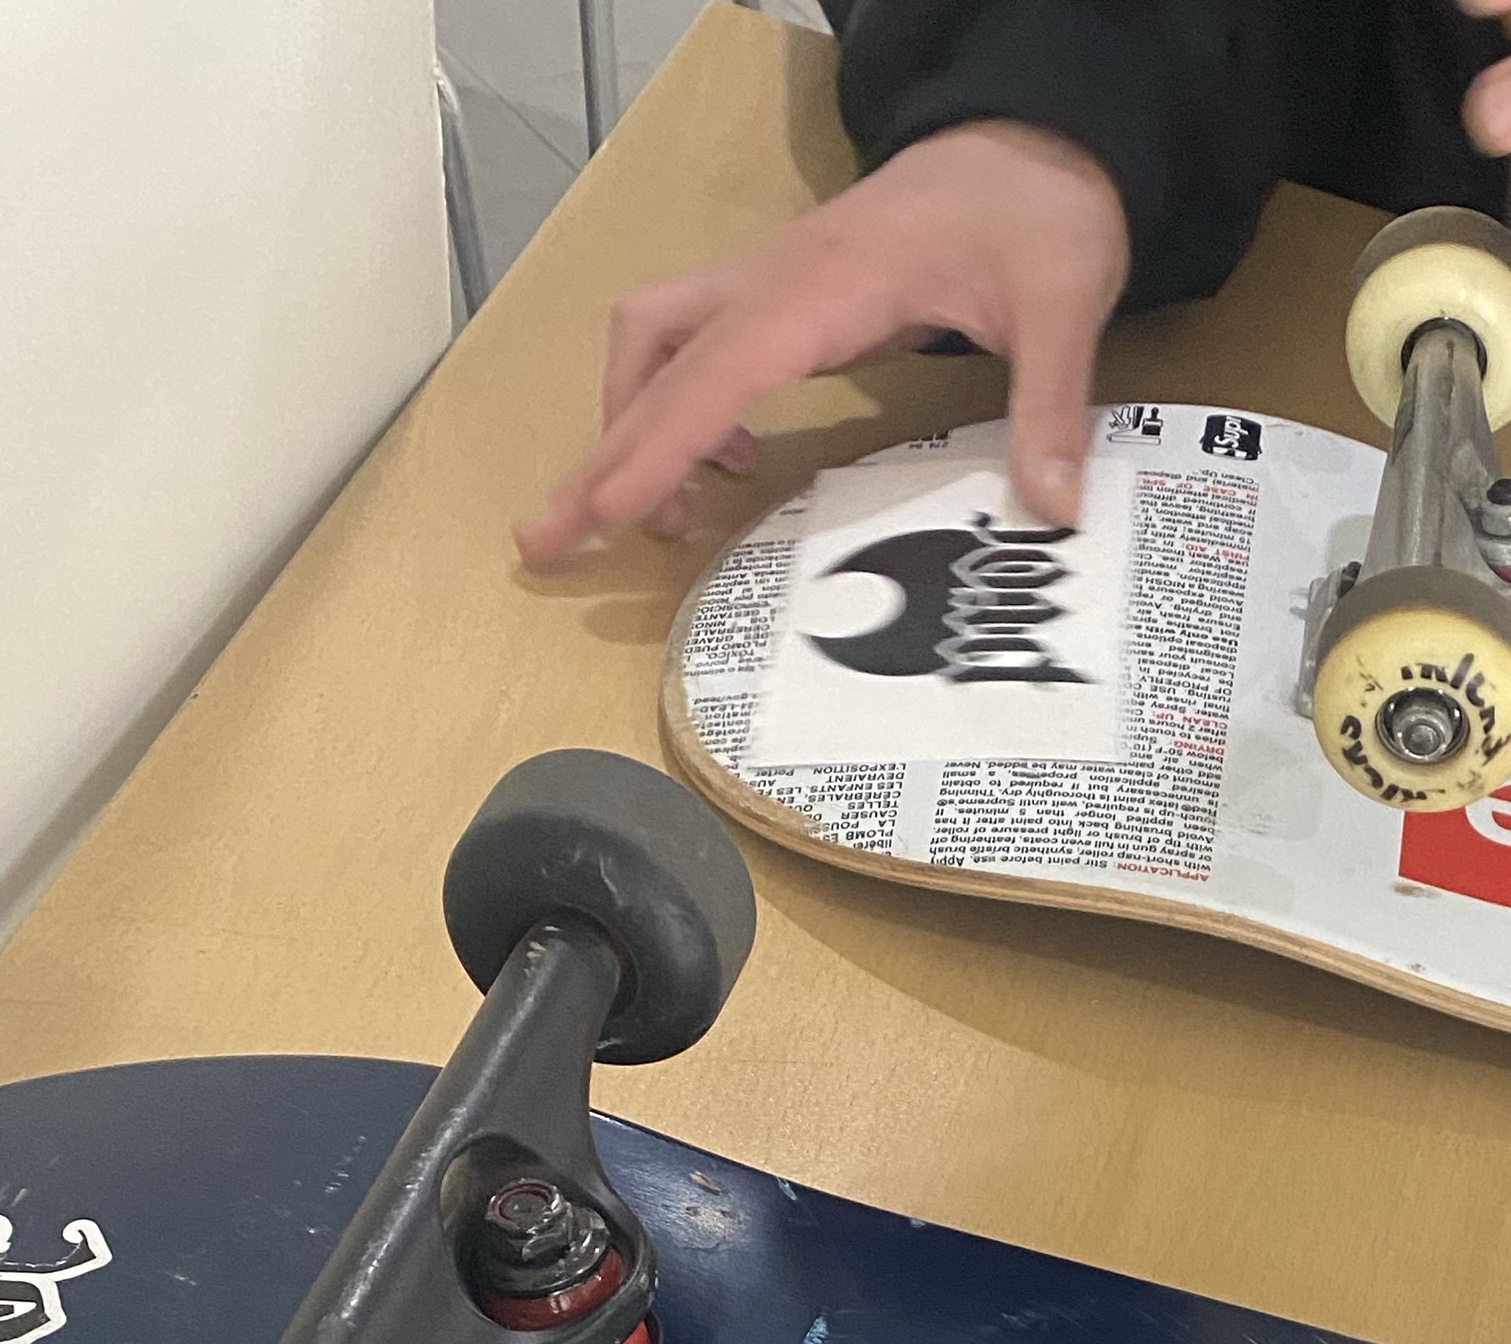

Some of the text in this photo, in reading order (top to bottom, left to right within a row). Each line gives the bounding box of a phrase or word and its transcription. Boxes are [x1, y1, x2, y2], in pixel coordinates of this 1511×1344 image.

[1149, 685, 1175, 694] USE
[1213, 685, 1232, 695] OF
[1132, 691, 1229, 711] final rinse with
[1150, 701, 1185, 713] Spray
[1148, 718, 1184, 728] hours
[1182, 715, 1227, 729] CLEAN
[1140, 726, 1225, 745] dries to touch
[1198, 726, 1226, 735] after
[1162, 755, 1178, 764] air
[1185, 750, 1223, 764] below
[1031, 762, 1046, 770] be
[1050, 762, 1076, 770] may
[1079, 764, 1115, 774] water
[1188, 760, 1222, 772] when
[754, 768, 794, 777] Porter
[824, 771, 904, 783] DEVRAIENT
[942, 770, 976, 778] small
[1118, 768, 1153, 777] clean
[1158, 764, 1221, 780] add other
[876, 781, 902, 789] LES
[940, 779, 980, 787] obtain
[1009, 779, 1063, 788] required
[1070, 782, 1079, 790] if
[1088, 774, 1159, 788] application
[1172, 775, 1220, 788] amount
[771, 786, 801, 795] LES
[938, 788, 994, 796] Thinning
[1087, 783, 1108, 792] but
[1171, 784, 1219, 798] desired
[1025, 787, 1094, 801] thoroughly
[1098, 794, 1109, 802] is
[1116, 785, 1198, 802] unnecessary
[847, 800, 898, 809] TELLES
[1018, 798, 1046, 806] until
[1112, 795, 1144, 804] paint
[1147, 799, 1178, 810] latex
[1206, 800, 1217, 808] is
[840, 809, 897, 819] CAUSER
[935, 808, 944, 816] If
[1036, 808, 1064, 816] than
[1074, 810, 1116, 820] longer
[1143, 806, 1154, 816] is
[934, 817, 956, 825] has
[962, 817, 970, 825] it
[1010, 816, 1042, 825] paint
[1125, 814, 1174, 826] applied
[1158, 808, 1216, 825] touch-up
[878, 819, 895, 827] LA
[1048, 818, 1072, 827] into
[1077, 820, 1108, 829] back
[972, 826, 986, 834] of
[990, 824, 1048, 834] pressure
[1052, 826, 1080, 837] light
[1114, 822, 1172, 837] brushing
[1183, 822, 1214, 834] been
[845, 828, 893, 840] PLOMB
[950, 834, 1016, 844] feathering
[1105, 832, 1142, 842] brush
[1176, 831, 1214, 844] Avoid
[929, 836, 948, 844] off
[1060, 837, 1091, 846] even
[1094, 840, 1114, 849] full
[1146, 836, 1160, 844] of
[1164, 836, 1180, 847] tip
[928, 845, 966, 856] brush
[968, 845, 1010, 855] bristle
[1013, 846, 1072, 854] synthetic
[1116, 842, 1128, 850] in
[1131, 842, 1156, 852] gun
[1185, 841, 1213, 852] with
[1158, 846, 1195, 858] spray
[929, 854, 964, 866] Apply
[1000, 855, 1042, 864] before
[1047, 856, 1080, 865] paint
[1083, 858, 1107, 868] Stir
[1116, 850, 1180, 866] short-nap
[1198, 854, 1212, 862] or
[1183, 860, 1210, 871] with
